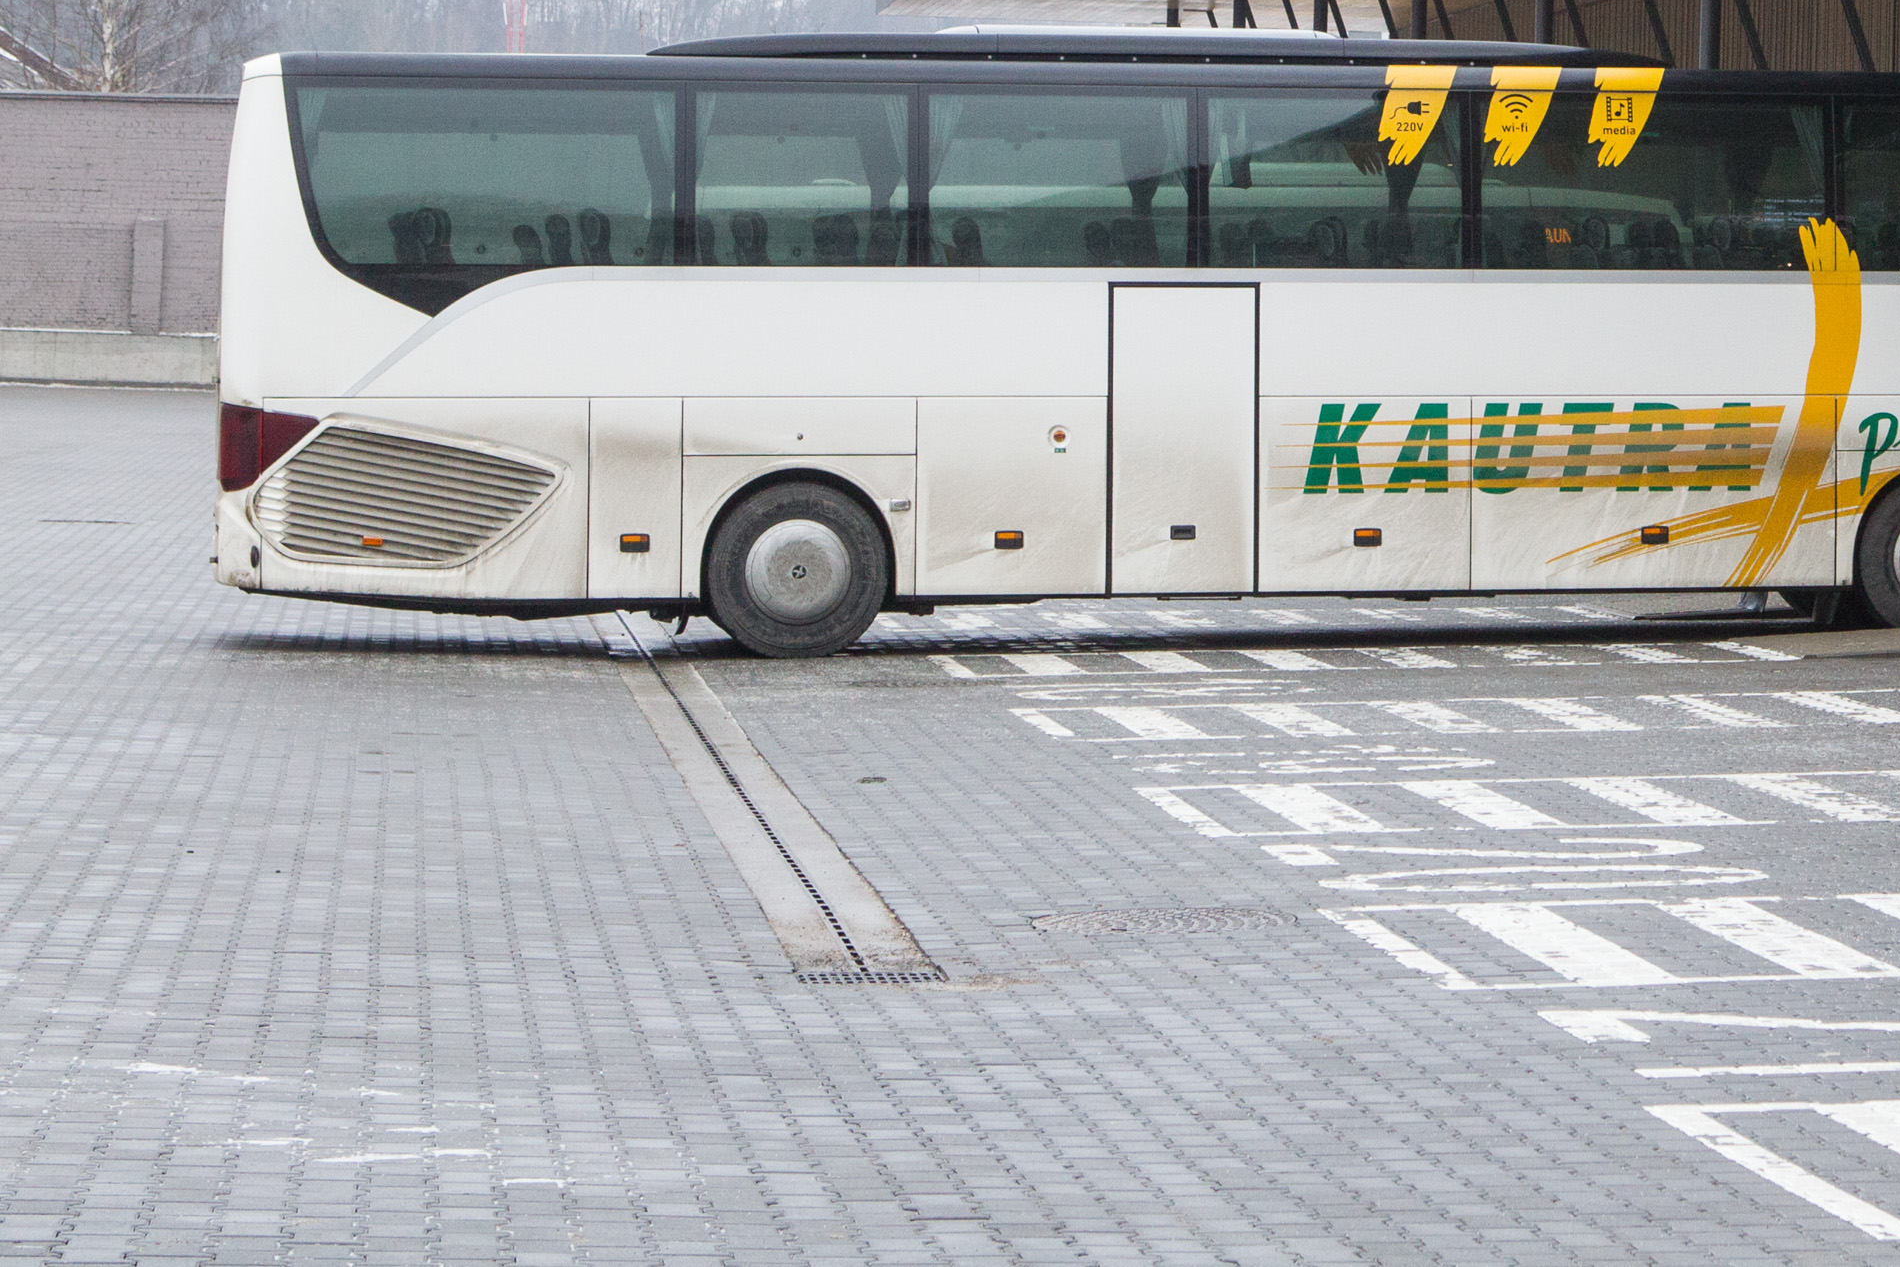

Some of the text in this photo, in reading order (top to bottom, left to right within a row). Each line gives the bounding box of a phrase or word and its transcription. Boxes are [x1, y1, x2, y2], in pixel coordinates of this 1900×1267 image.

[1396, 122, 1424, 132] 220V
[1501, 123, 1528, 133] wi-fi
[1603, 125, 1636, 135] media
[1303, 402, 1751, 494] KAUTRA
